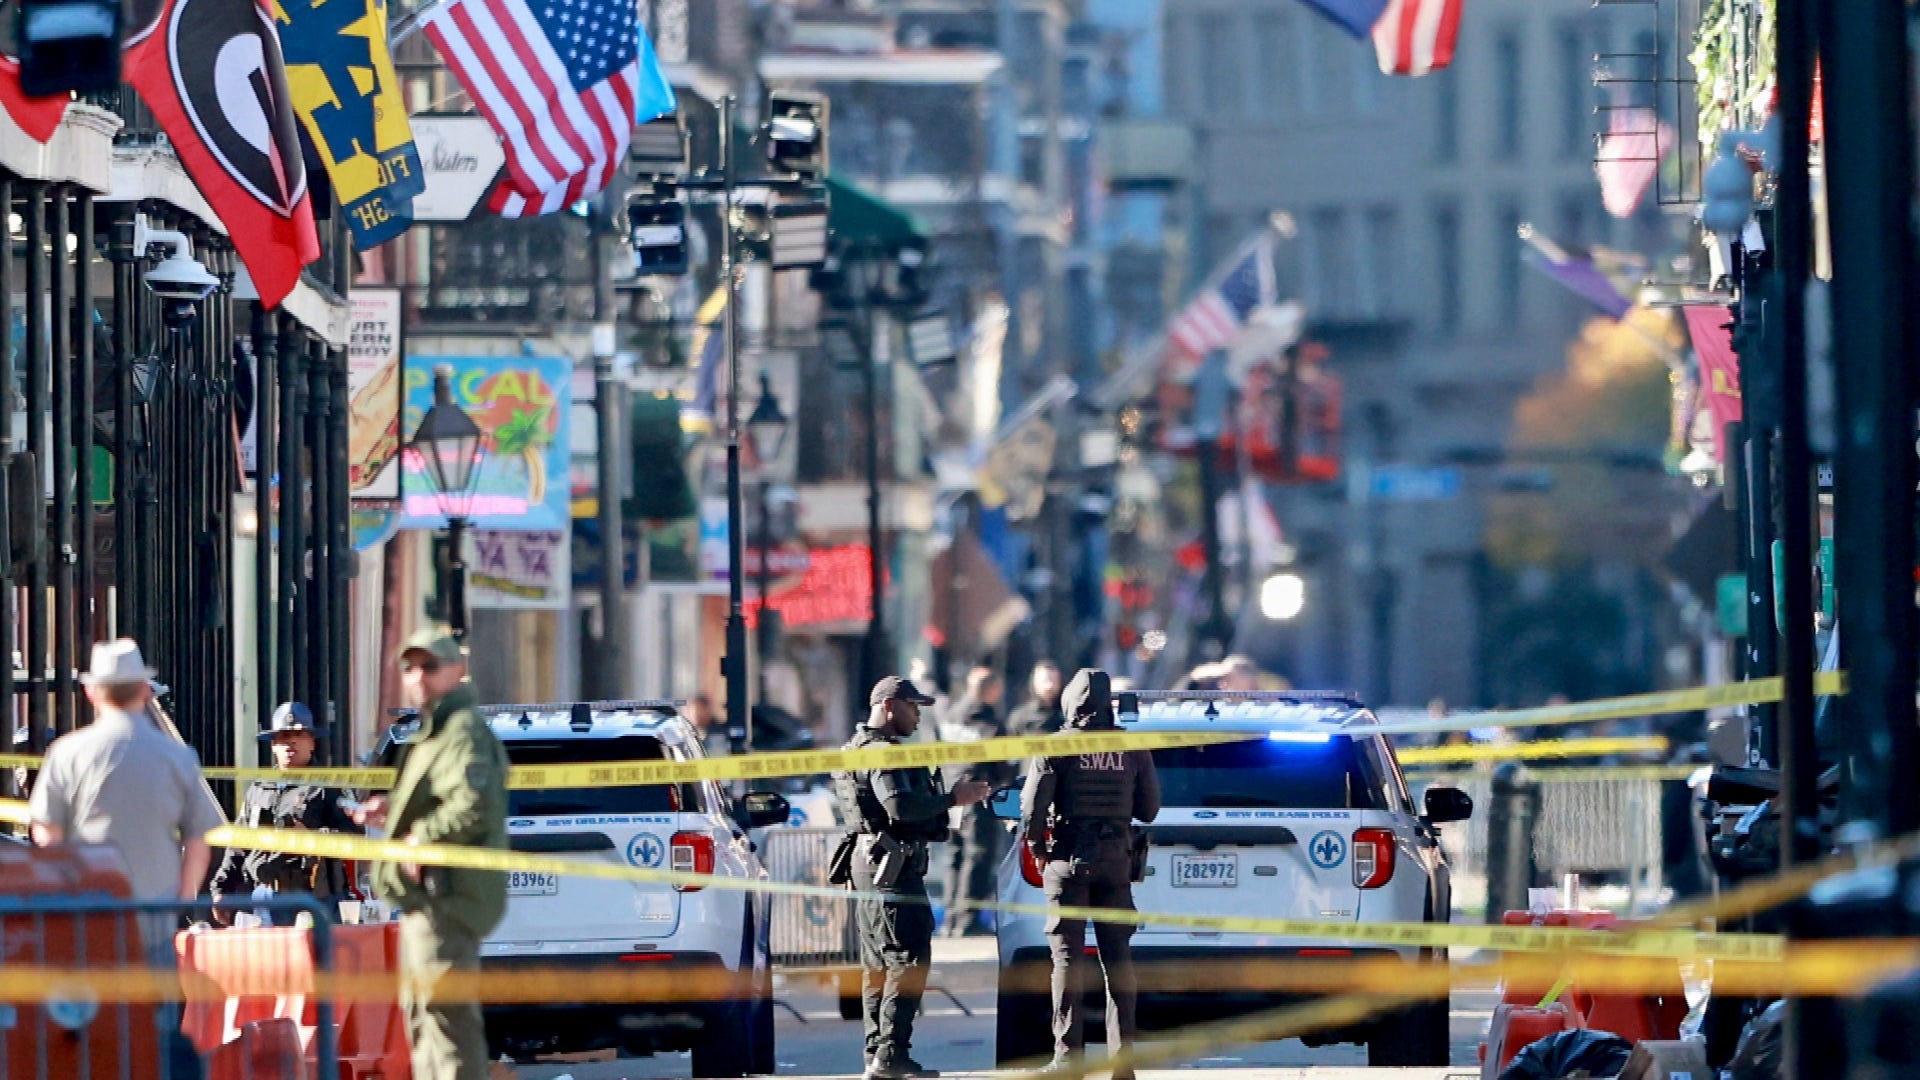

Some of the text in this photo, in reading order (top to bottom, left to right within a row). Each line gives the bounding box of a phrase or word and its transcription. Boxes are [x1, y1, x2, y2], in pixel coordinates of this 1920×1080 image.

[404, 367, 557, 405] PCAL
[475, 539, 552, 579] YA YA
[546, 819, 572, 827] NEW
[575, 817, 630, 825] ORLEANS
[1255, 811, 1309, 819] ORLEANS
[1312, 811, 1351, 819] POLICE
[1184, 863, 1235, 879] 282972
